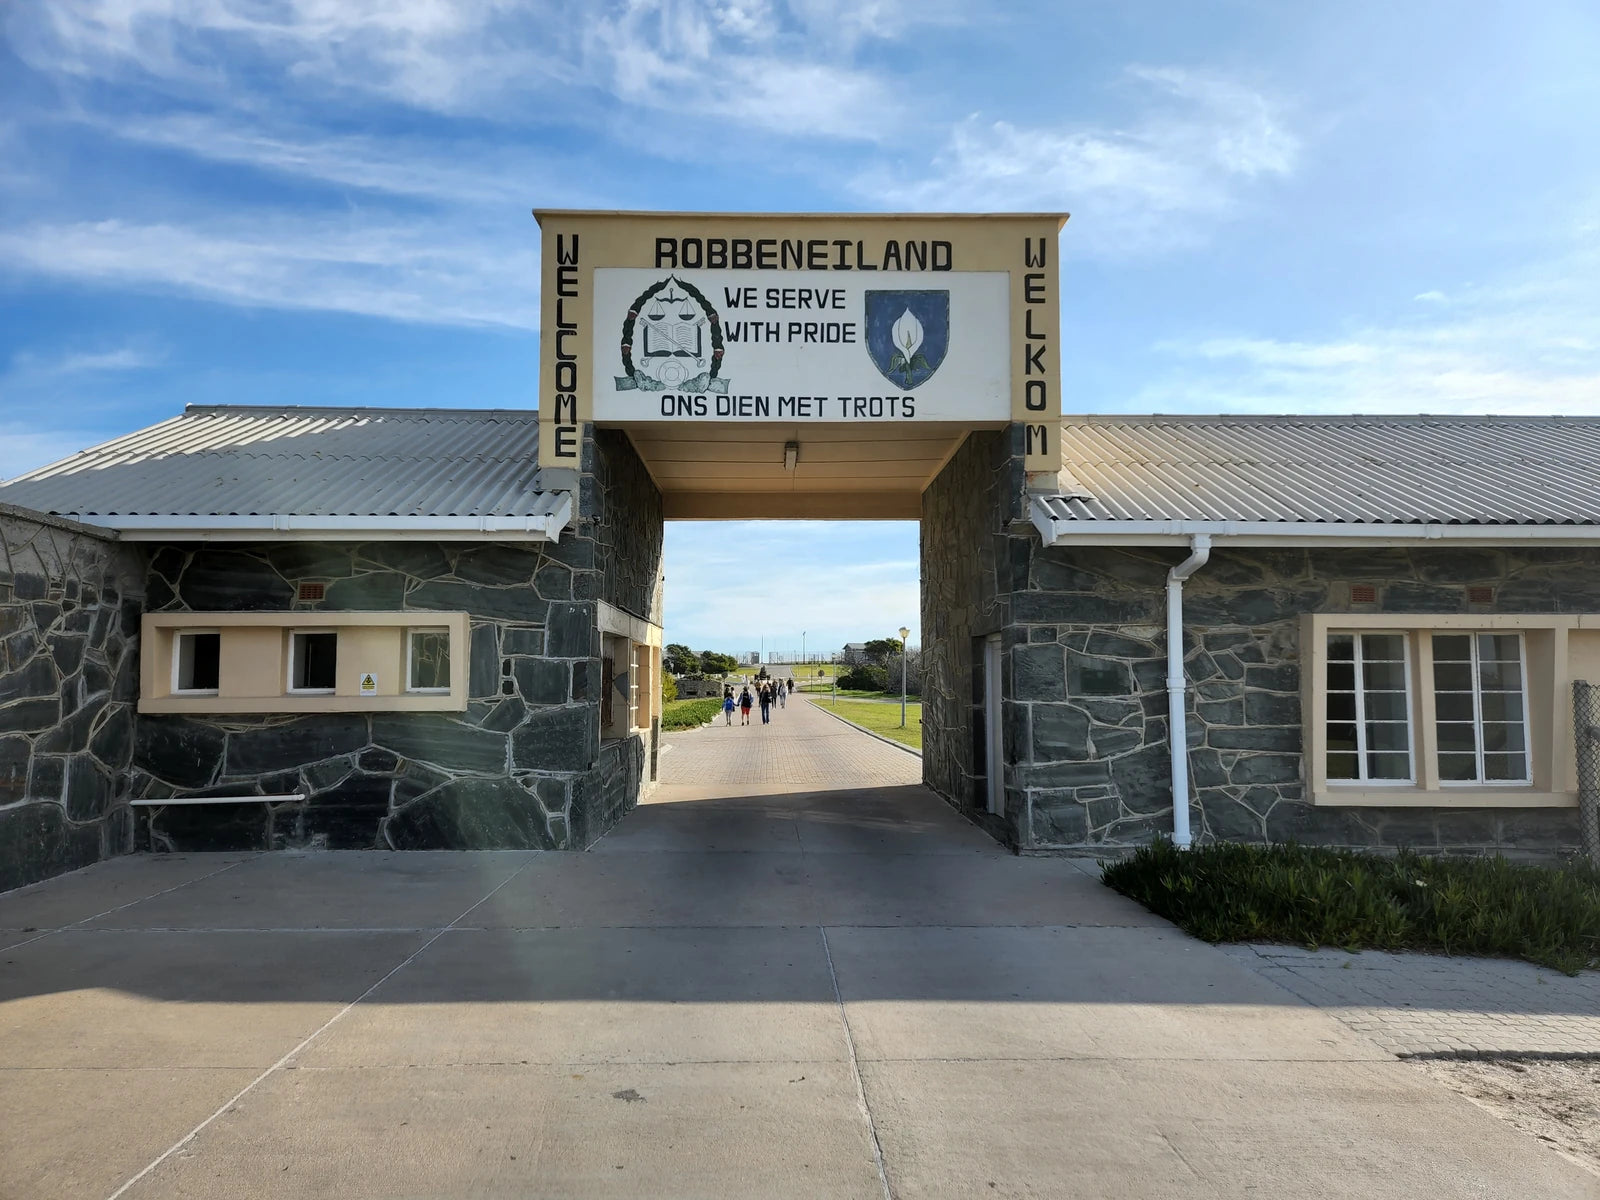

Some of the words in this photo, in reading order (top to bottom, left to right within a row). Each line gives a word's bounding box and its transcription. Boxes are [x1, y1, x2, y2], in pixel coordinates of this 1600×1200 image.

[654, 237, 953, 271] ROBBENEILAND
[724, 287, 758, 309] WE
[765, 288, 846, 310] SERVE
[554, 233, 579, 458] WELCOME
[724, 321, 780, 343] WITH
[788, 322, 856, 344] PRIDE
[1024, 237, 1047, 456] WELKOM
[661, 394, 708, 417] ONS
[716, 395, 770, 417] DIEN
[778, 396, 828, 417] MET
[837, 396, 915, 418] TROTS
